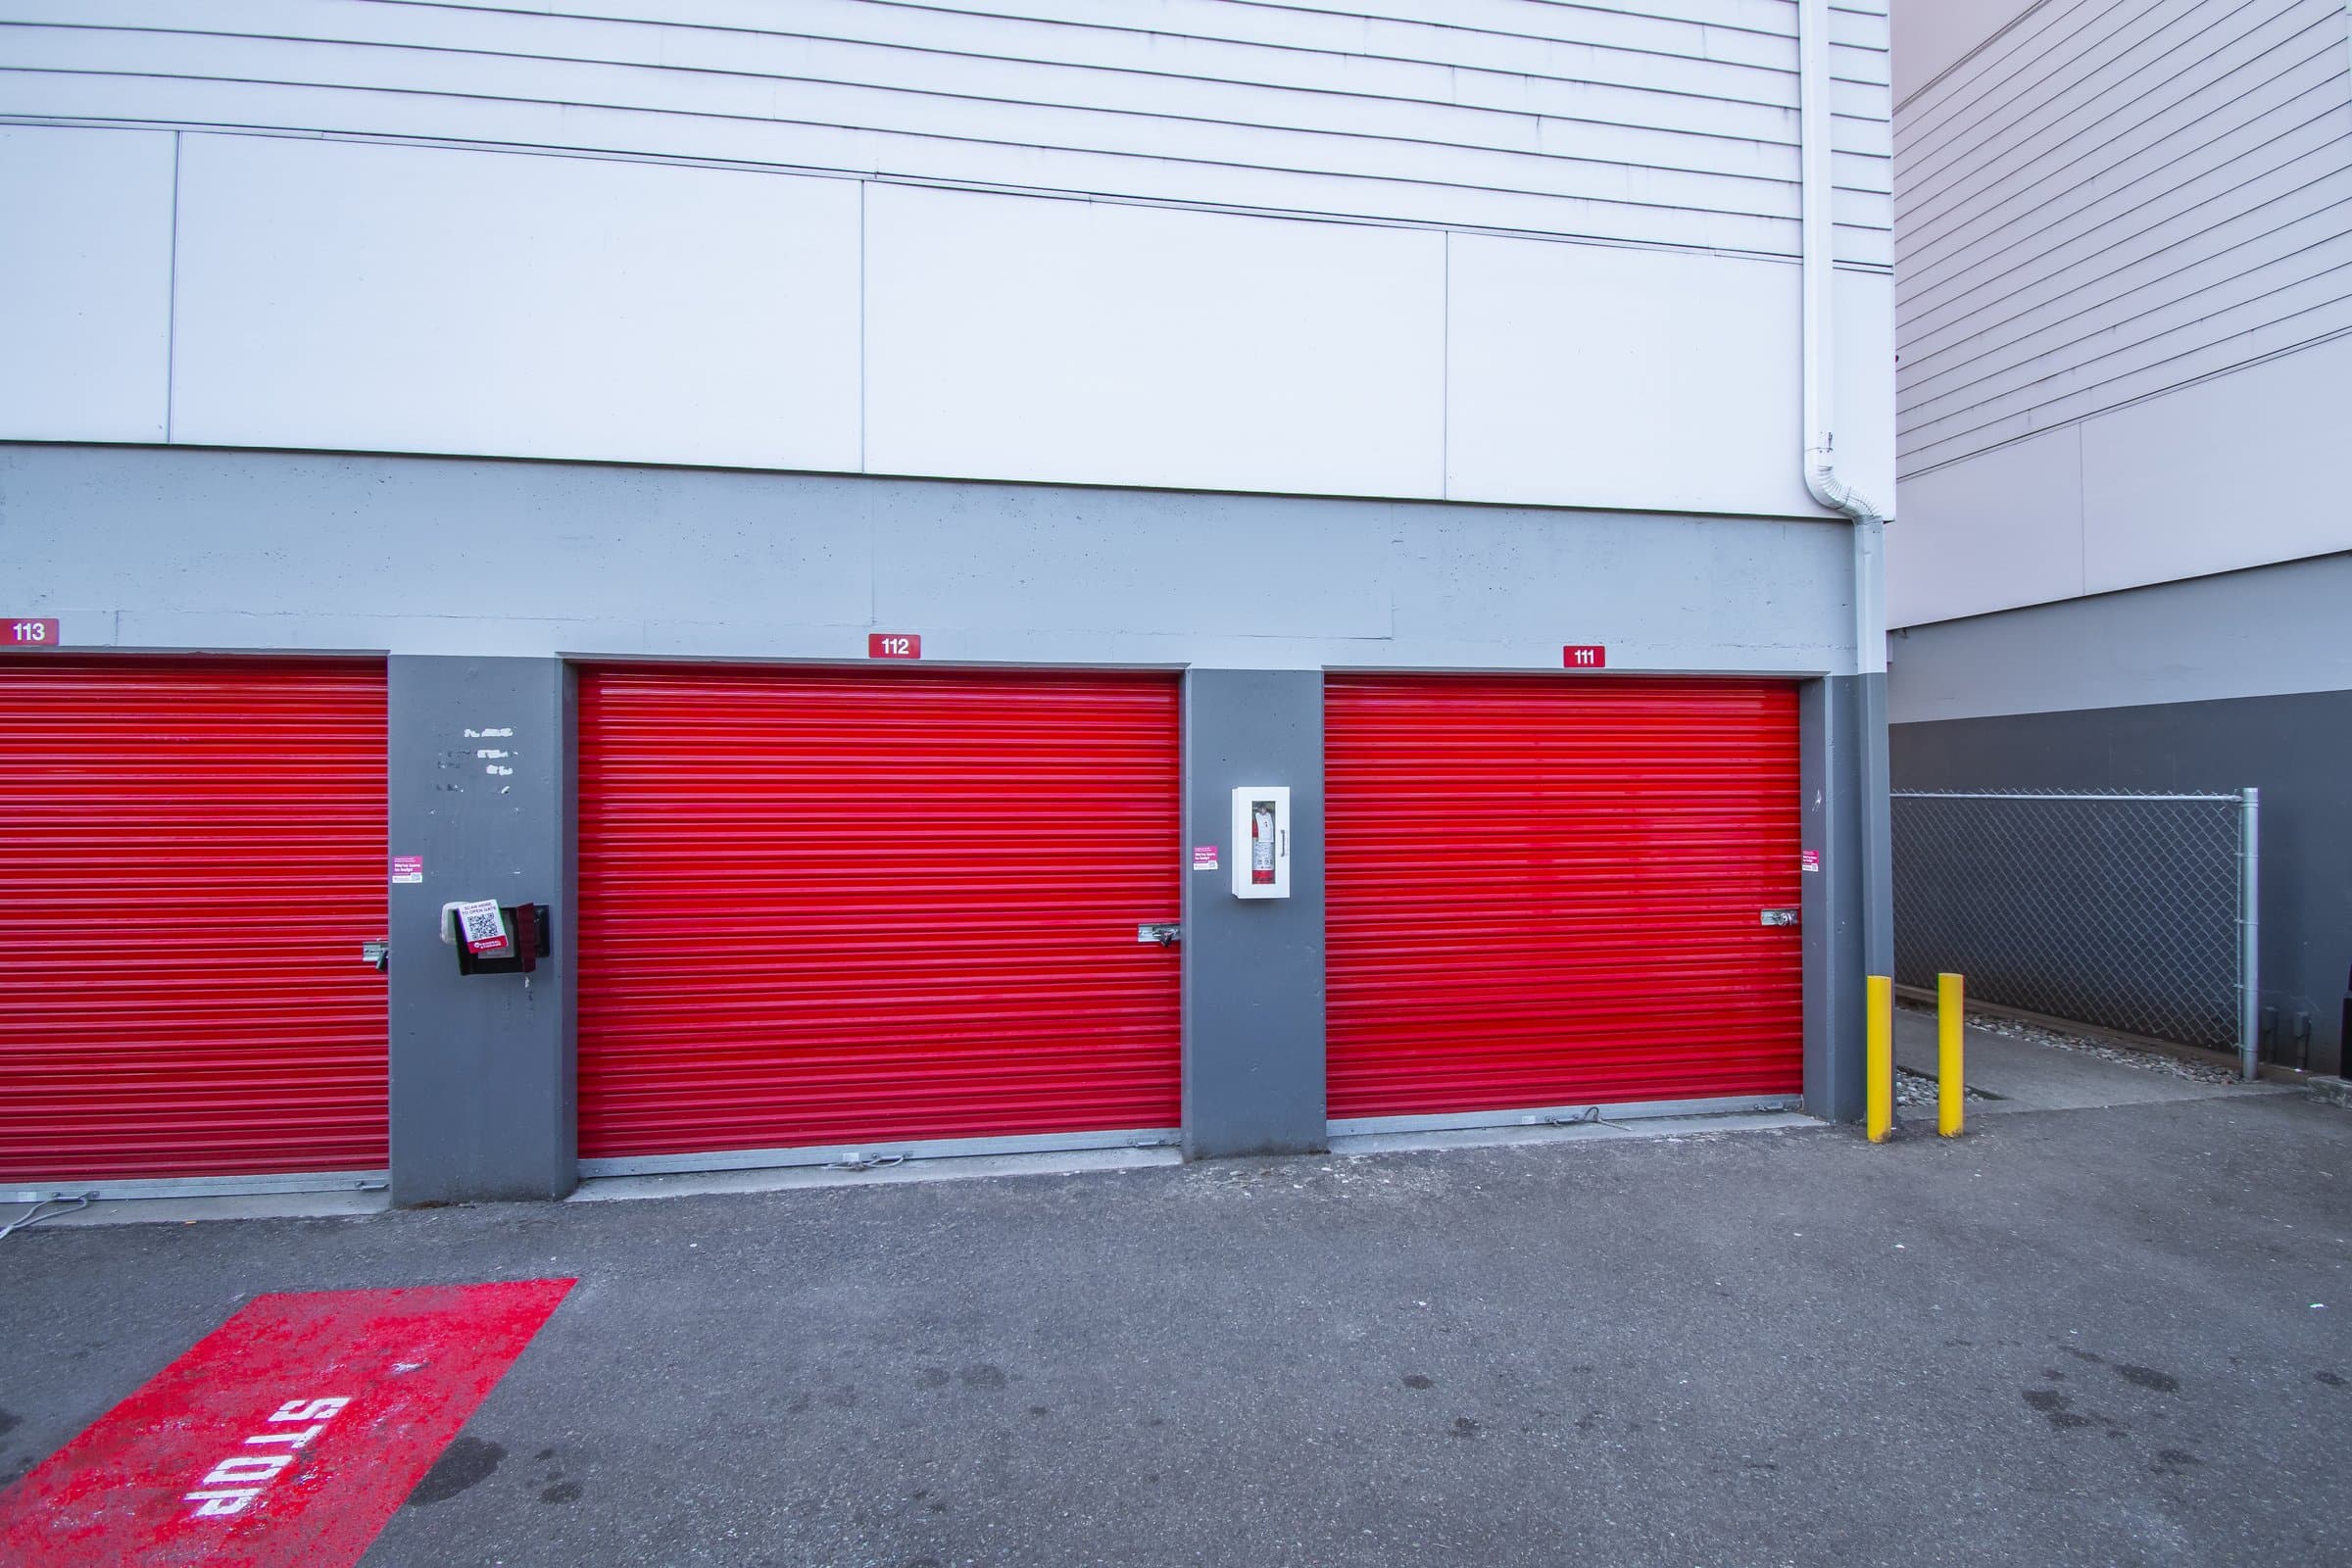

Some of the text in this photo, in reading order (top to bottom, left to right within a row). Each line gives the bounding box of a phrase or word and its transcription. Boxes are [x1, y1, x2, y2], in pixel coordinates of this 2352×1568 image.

[13, 622, 46, 642] 113
[881, 638, 909, 655] 112
[1574, 649, 1594, 664] 111
[182, 1396, 352, 1517] STOP
